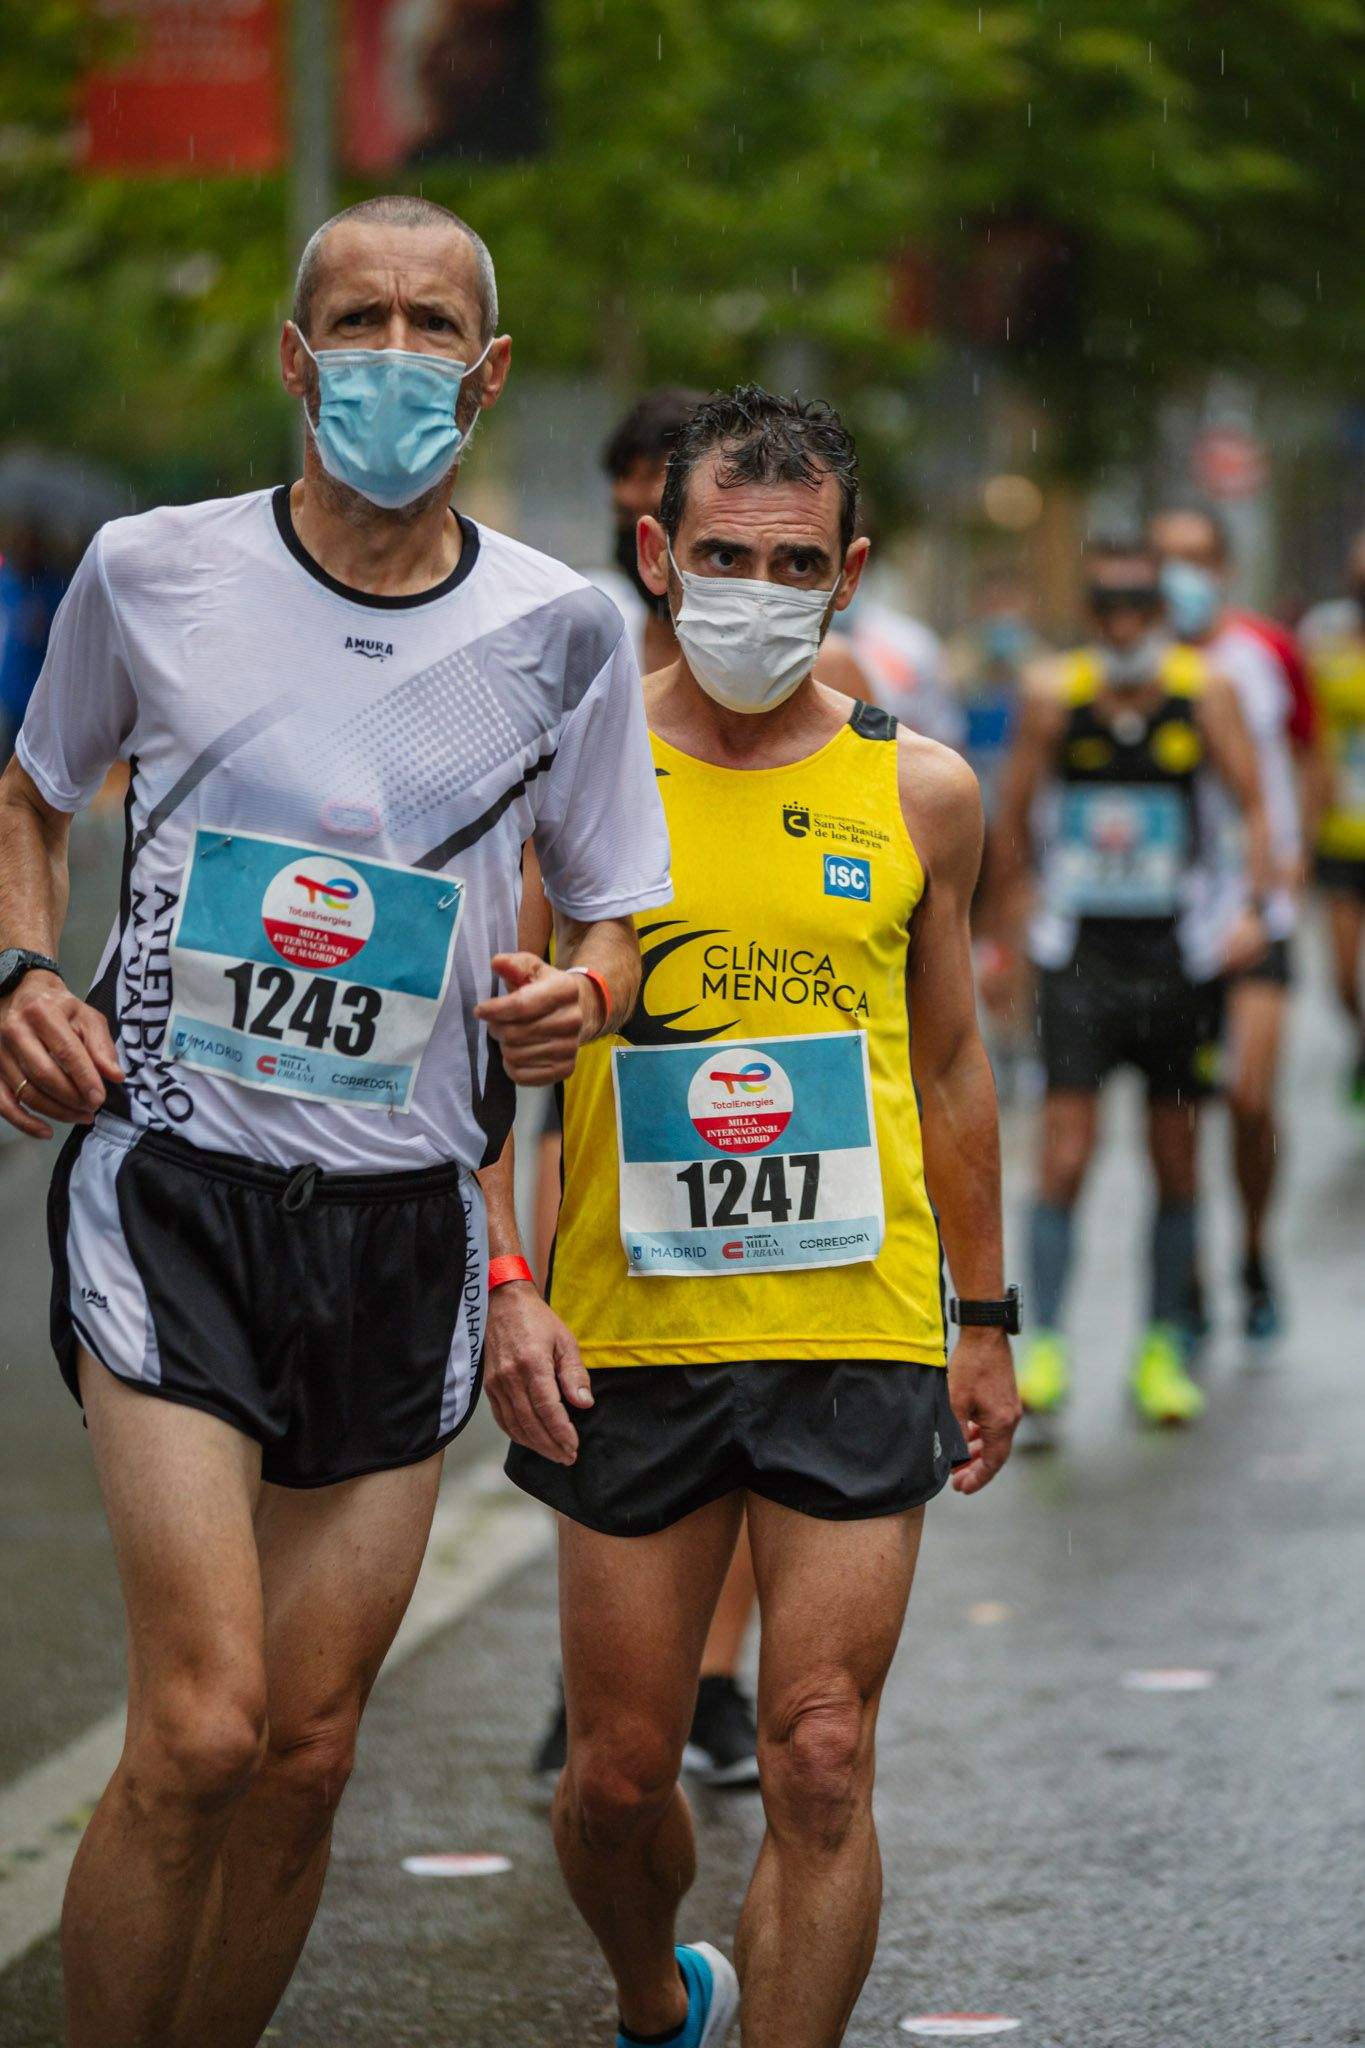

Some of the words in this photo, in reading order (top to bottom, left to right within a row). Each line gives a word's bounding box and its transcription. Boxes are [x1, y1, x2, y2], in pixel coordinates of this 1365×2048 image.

[344, 636, 393, 655] AMURA
[814, 818, 835, 829] San
[838, 821, 890, 842] Sebastián
[814, 829, 828, 838] de
[831, 830, 848, 840] los
[851, 833, 882, 849] Reyes
[829, 864, 865, 890] ISC
[288, 906, 352, 927] TotalEnergies
[299, 928, 329, 943] MILLA
[282, 945, 296, 957] DE
[297, 948, 338, 964] MADRID
[704, 941, 836, 979] CLÍNICA
[702, 972, 870, 1018] MENORCA
[224, 962, 383, 1058] 1243
[194, 1041, 243, 1063] MADRID
[279, 1058, 312, 1073] MILLA
[711, 1098, 774, 1110] TotalEnergies
[727, 1117, 758, 1127] MILLA
[718, 1137, 732, 1146] DE
[733, 1135, 770, 1146] MADRID
[676, 1153, 820, 1229] 1247
[651, 1246, 707, 1259] MADRID
[746, 1239, 779, 1249] MILLA
[746, 1247, 785, 1258] URBANA
